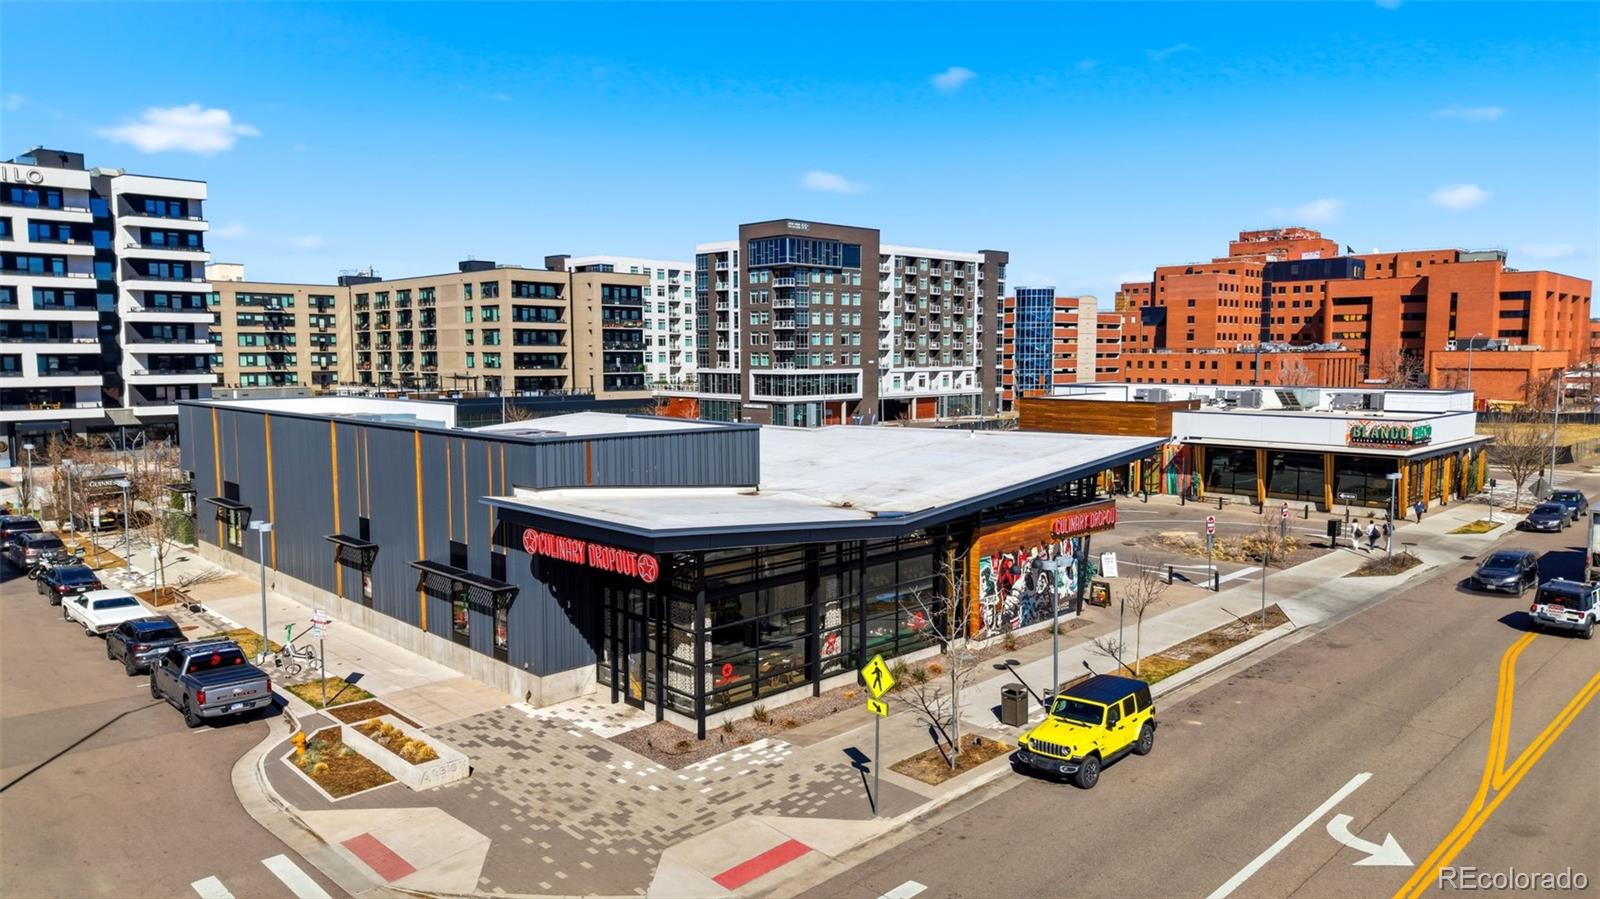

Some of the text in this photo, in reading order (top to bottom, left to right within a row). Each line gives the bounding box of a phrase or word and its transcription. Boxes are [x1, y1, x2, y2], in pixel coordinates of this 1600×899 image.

[1090, 508, 1117, 528] DROPOU
[537, 532, 638, 577] CULINARY DROPOUT
